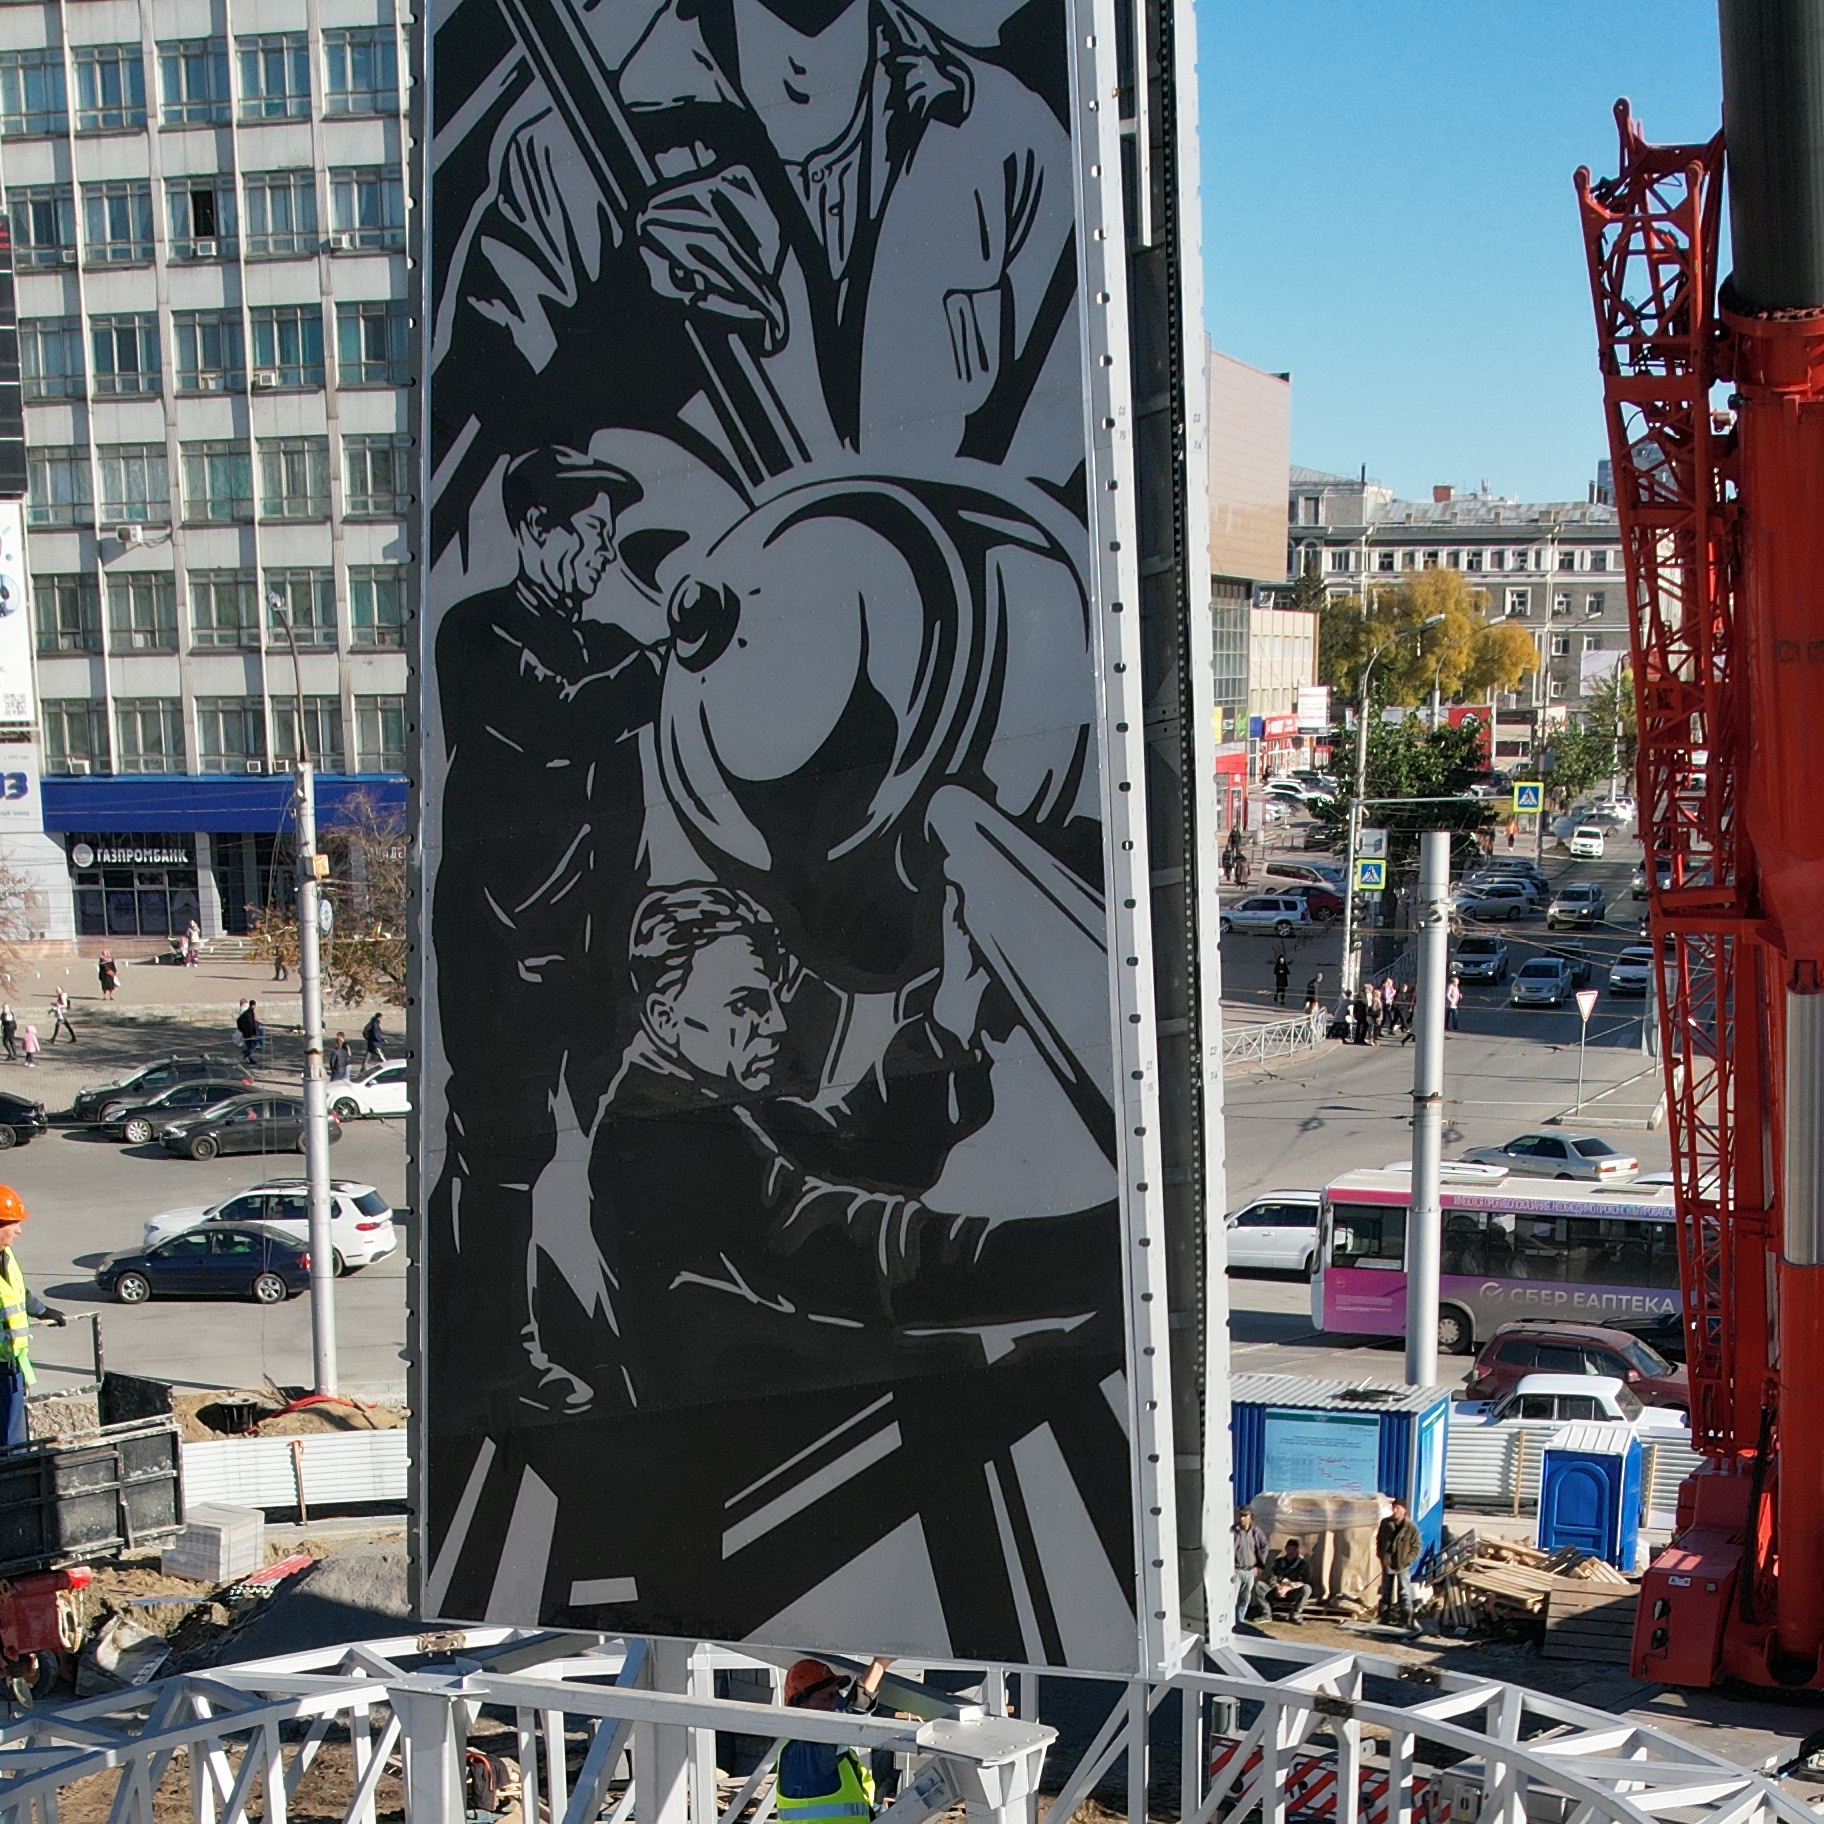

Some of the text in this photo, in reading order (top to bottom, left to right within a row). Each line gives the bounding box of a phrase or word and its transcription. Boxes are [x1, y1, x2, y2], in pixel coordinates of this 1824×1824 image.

[97, 847, 188, 864] ГАЗПРОМБАНК
[1510, 1288, 1675, 1314] СБЕР ЕАПТЕКА
